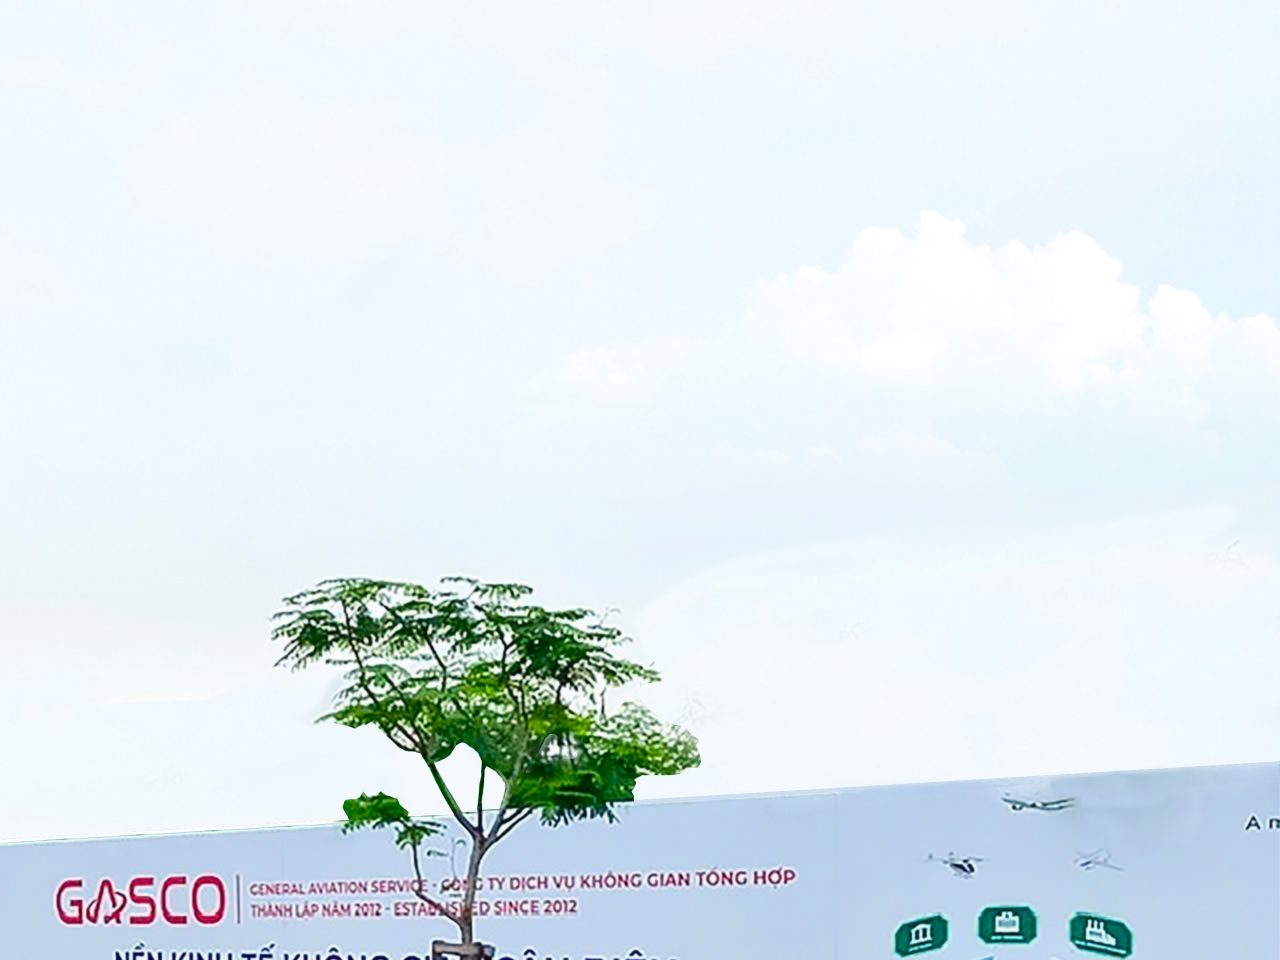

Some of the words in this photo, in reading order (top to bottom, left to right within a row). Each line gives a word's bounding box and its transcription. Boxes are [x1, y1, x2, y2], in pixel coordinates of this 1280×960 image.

[249, 883, 305, 896] GENERAL
[308, 881, 368, 895] AVIATION
[371, 879, 428, 893] SERVICE
[488, 877, 506, 890] TY
[510, 876, 548, 892] DỊCH
[552, 875, 575, 892] VỤ
[580, 871, 642, 889] KHÔNG
[647, 872, 690, 888] GIAN
[753, 867, 796, 888] HỢP
[56, 875, 226, 924] GASCO
[354, 903, 382, 917] 2012
[394, 900, 490, 916] ESTABISED
[494, 900, 539, 915] SINCE
[544, 900, 577, 915] 2012
